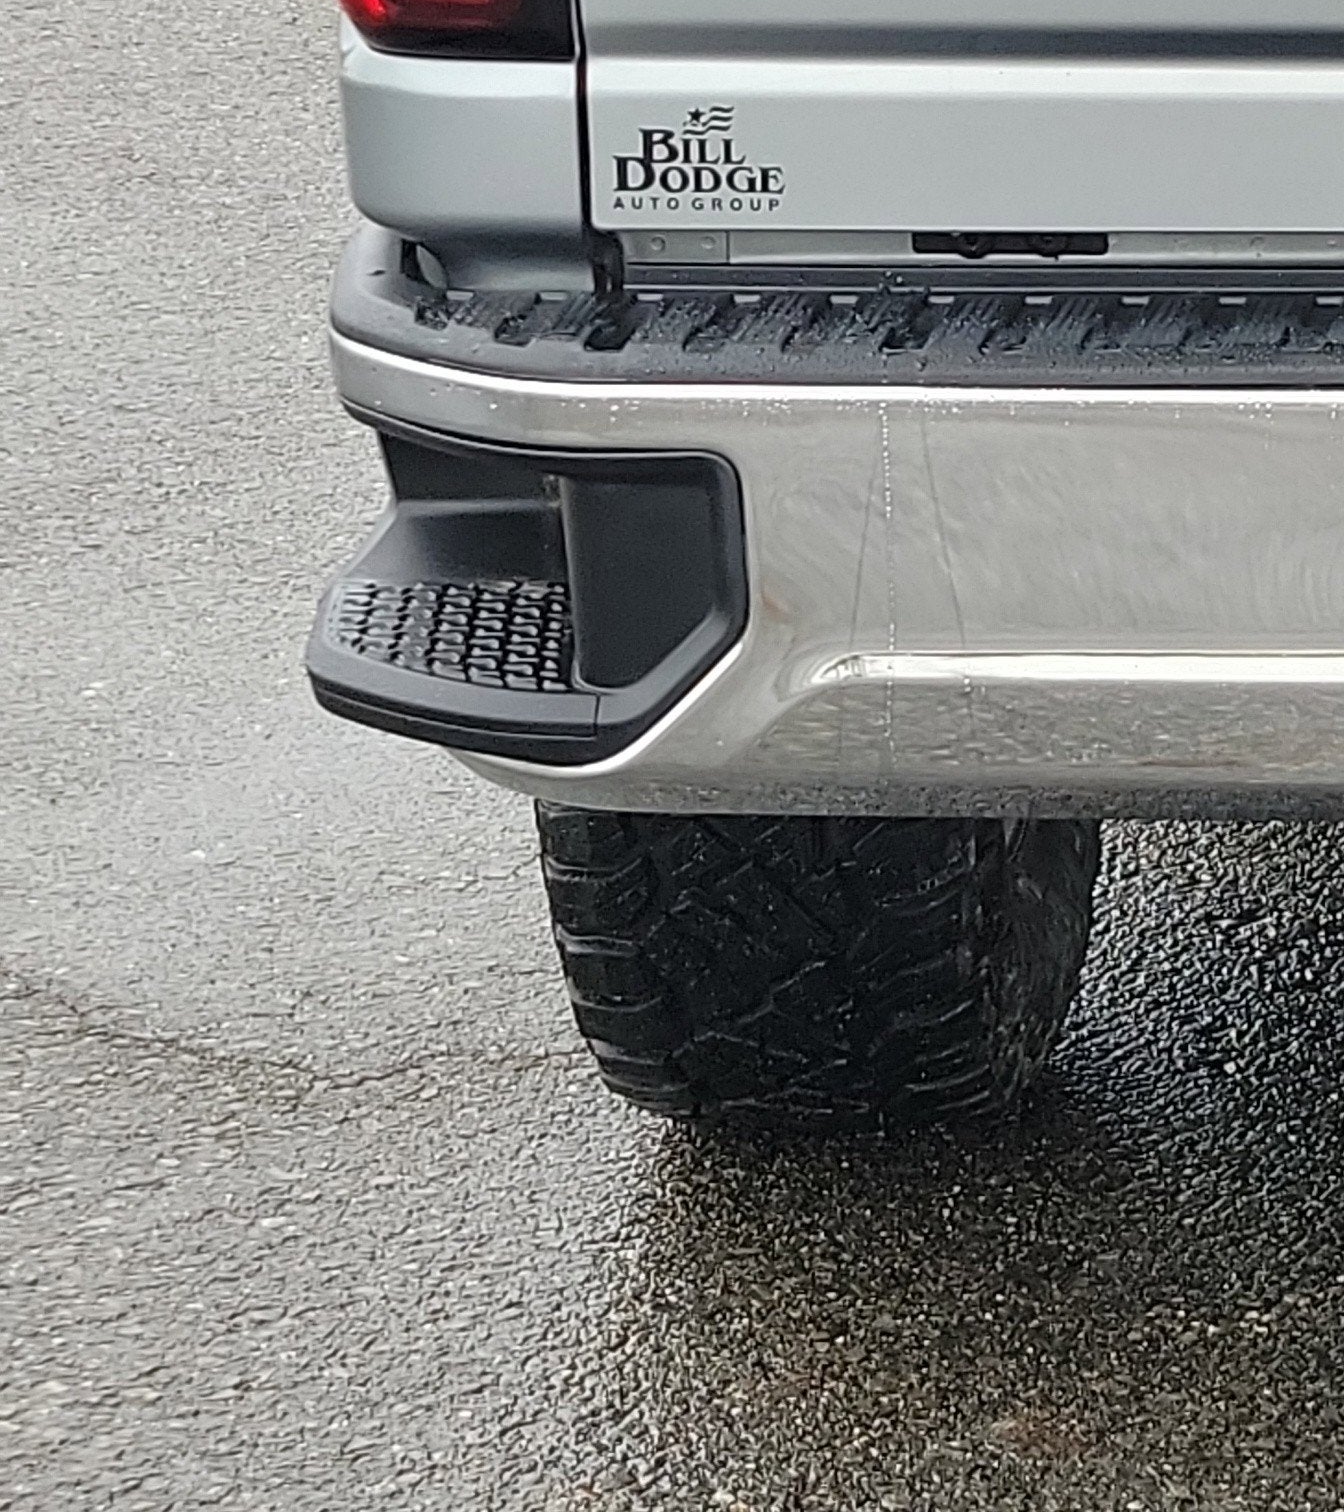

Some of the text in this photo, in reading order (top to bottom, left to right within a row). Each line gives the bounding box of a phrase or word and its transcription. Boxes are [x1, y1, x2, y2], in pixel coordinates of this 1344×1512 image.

[638, 128, 746, 165] BILL
[613, 155, 786, 194] DODGE
[613, 197, 780, 211] AUTO GROUP
